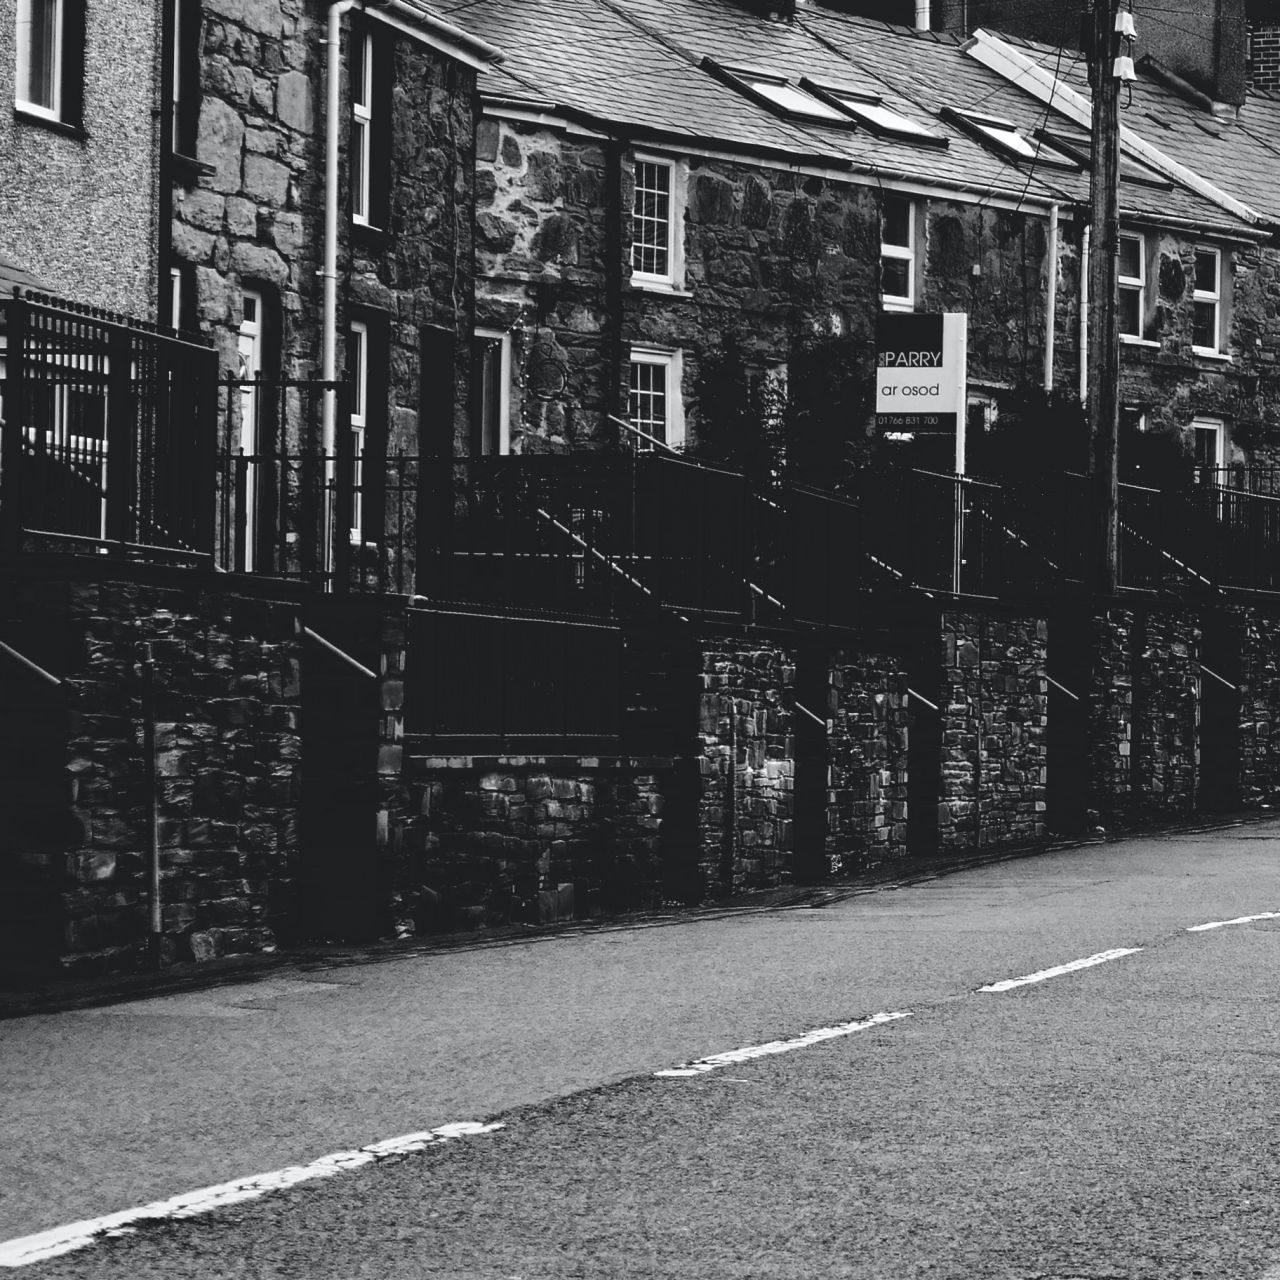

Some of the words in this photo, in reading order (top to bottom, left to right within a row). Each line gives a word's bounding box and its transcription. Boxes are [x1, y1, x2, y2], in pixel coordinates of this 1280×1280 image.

[885, 351, 941, 367] PARRY
[881, 385, 898, 396] ar
[901, 383, 940, 396] osod
[878, 416, 903, 424] 01766
[923, 416, 938, 424] 700
